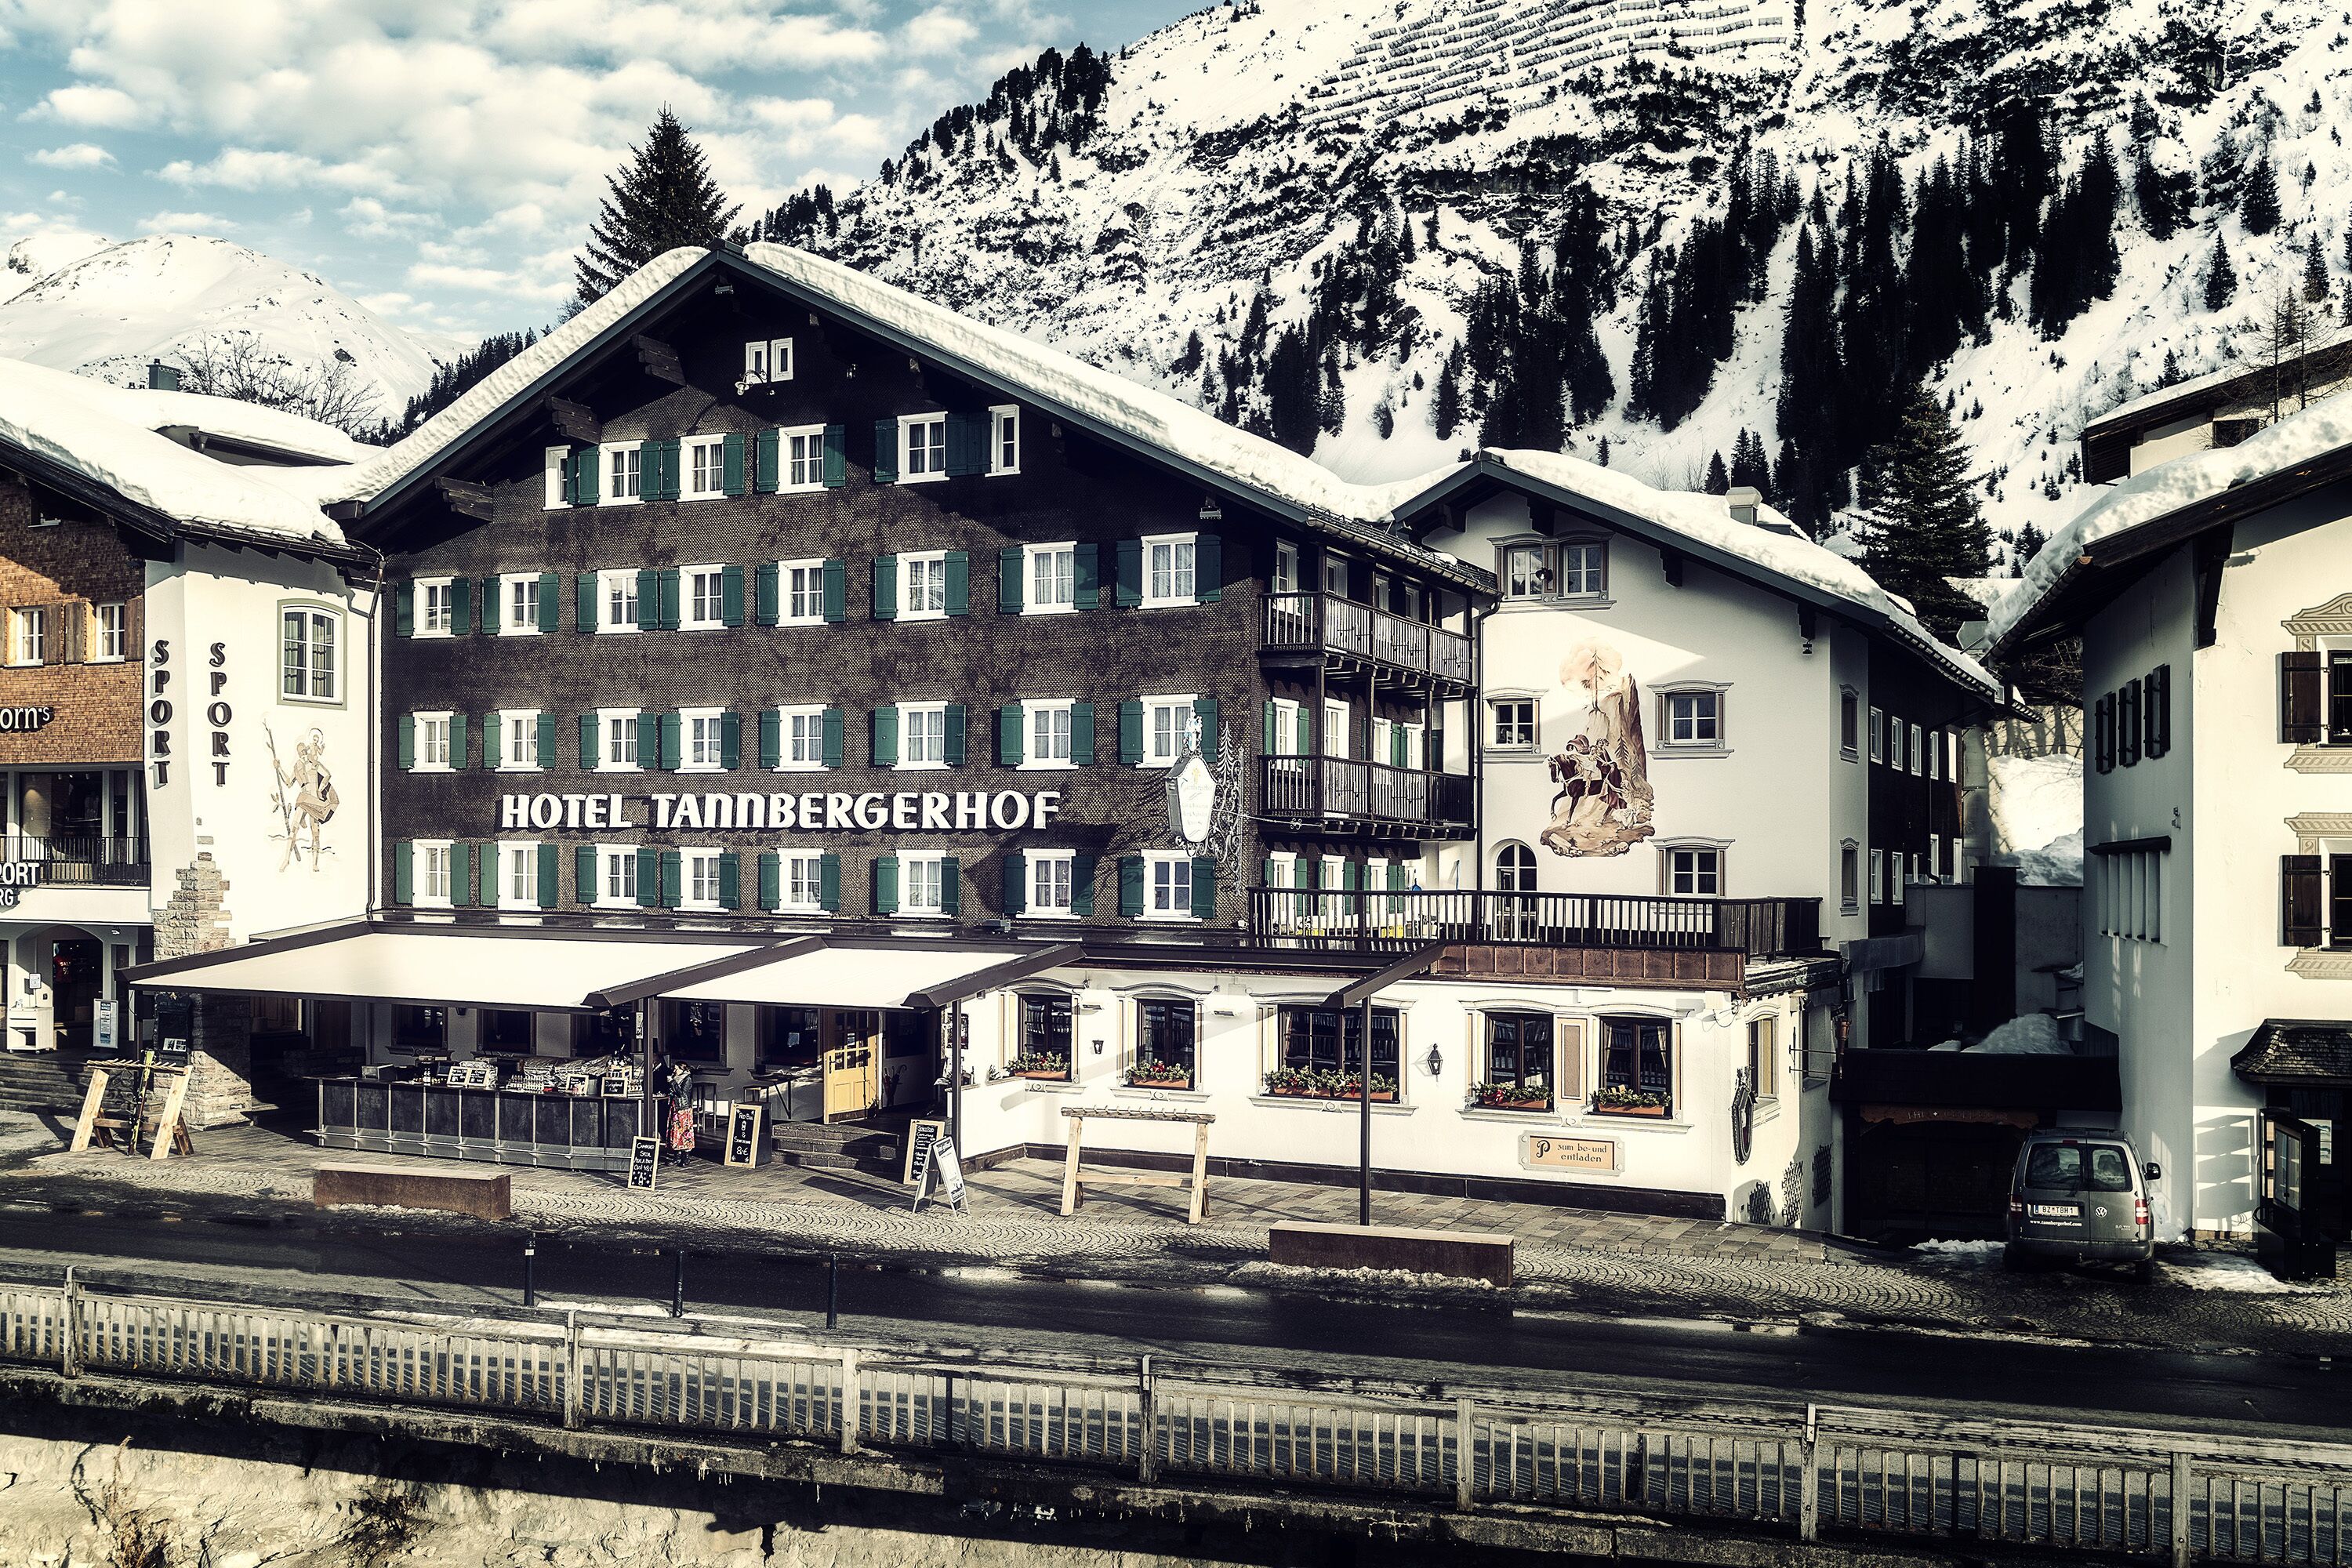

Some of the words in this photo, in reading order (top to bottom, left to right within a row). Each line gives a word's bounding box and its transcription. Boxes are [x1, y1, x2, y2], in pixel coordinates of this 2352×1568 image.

[151, 640, 172, 784] SPORT
[207, 642, 232, 787] SPORT
[501, 793, 633, 829] HOTEL
[651, 789, 1060, 829] TANNBERGERHOF
[0, 862, 40, 885] ORT
[1536, 1139, 1551, 1158] P
[1560, 1152, 1602, 1163] entladen
